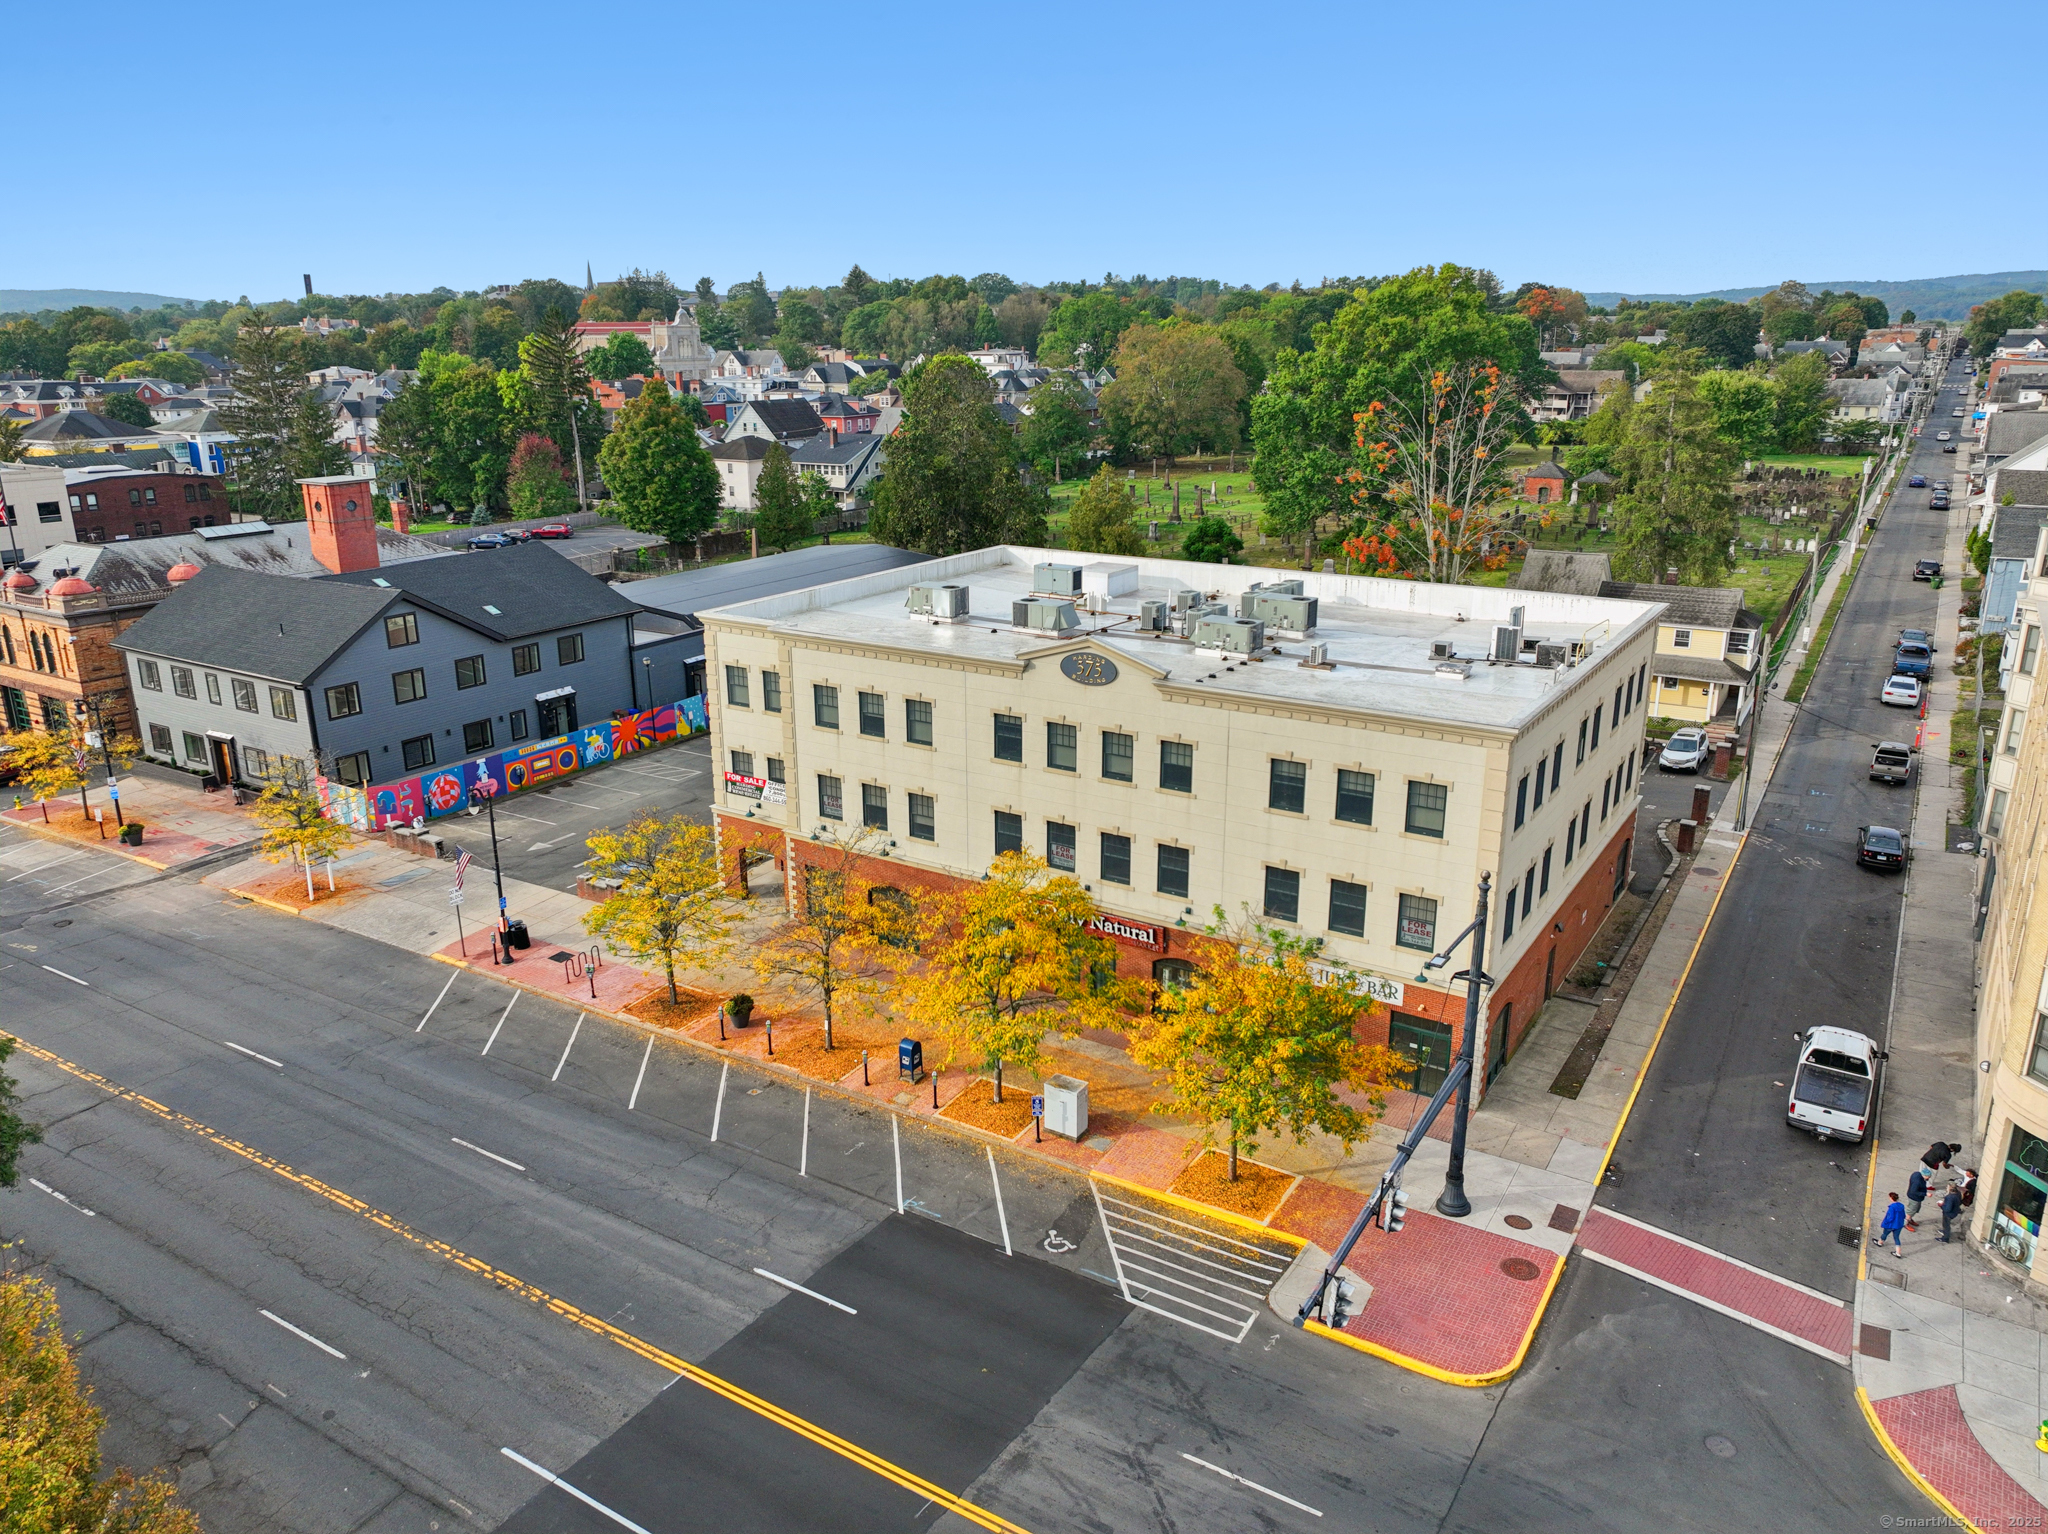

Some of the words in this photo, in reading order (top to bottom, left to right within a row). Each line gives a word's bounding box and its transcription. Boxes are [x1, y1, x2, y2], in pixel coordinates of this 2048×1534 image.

[1077, 660, 1102, 677] 575
[727, 773, 742, 782] FOR
[744, 777, 764, 787] SALE
[823, 800, 842, 809] LEASE
[1051, 850, 1074, 860] LEASE
[1055, 845, 1071, 854] FOR
[1090, 915, 1155, 944] Natural
[1407, 920, 1427, 930] FOR
[1401, 926, 1432, 937] LEASE
[1367, 980, 1399, 1001] BAR
